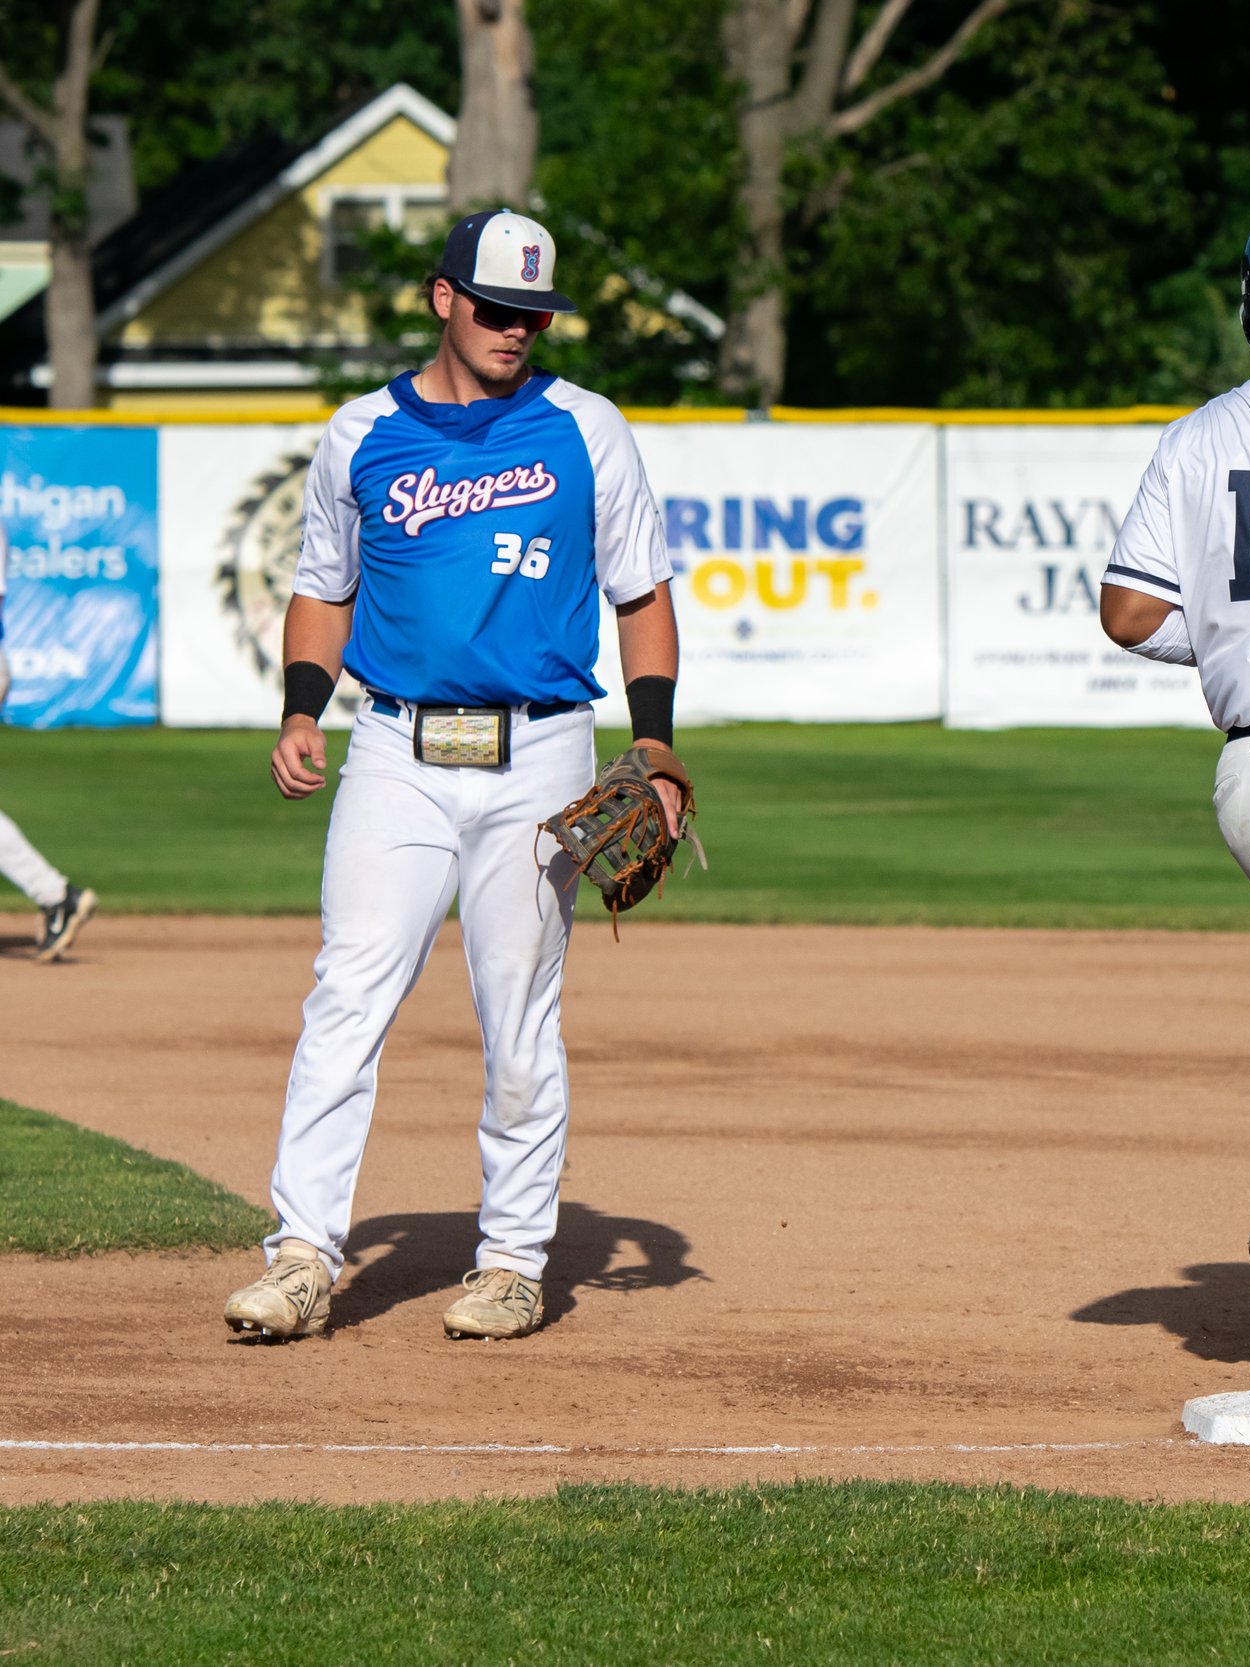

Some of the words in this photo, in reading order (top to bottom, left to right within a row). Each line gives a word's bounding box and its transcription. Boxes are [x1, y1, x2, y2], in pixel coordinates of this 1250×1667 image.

[1, 471, 126, 530] higan
[382, 462, 557, 537] Sluggers
[664, 496, 864, 551] RING
[491, 533, 552, 580] 36
[692, 559, 879, 610] OUT.
[1017, 562, 1101, 615] JA
